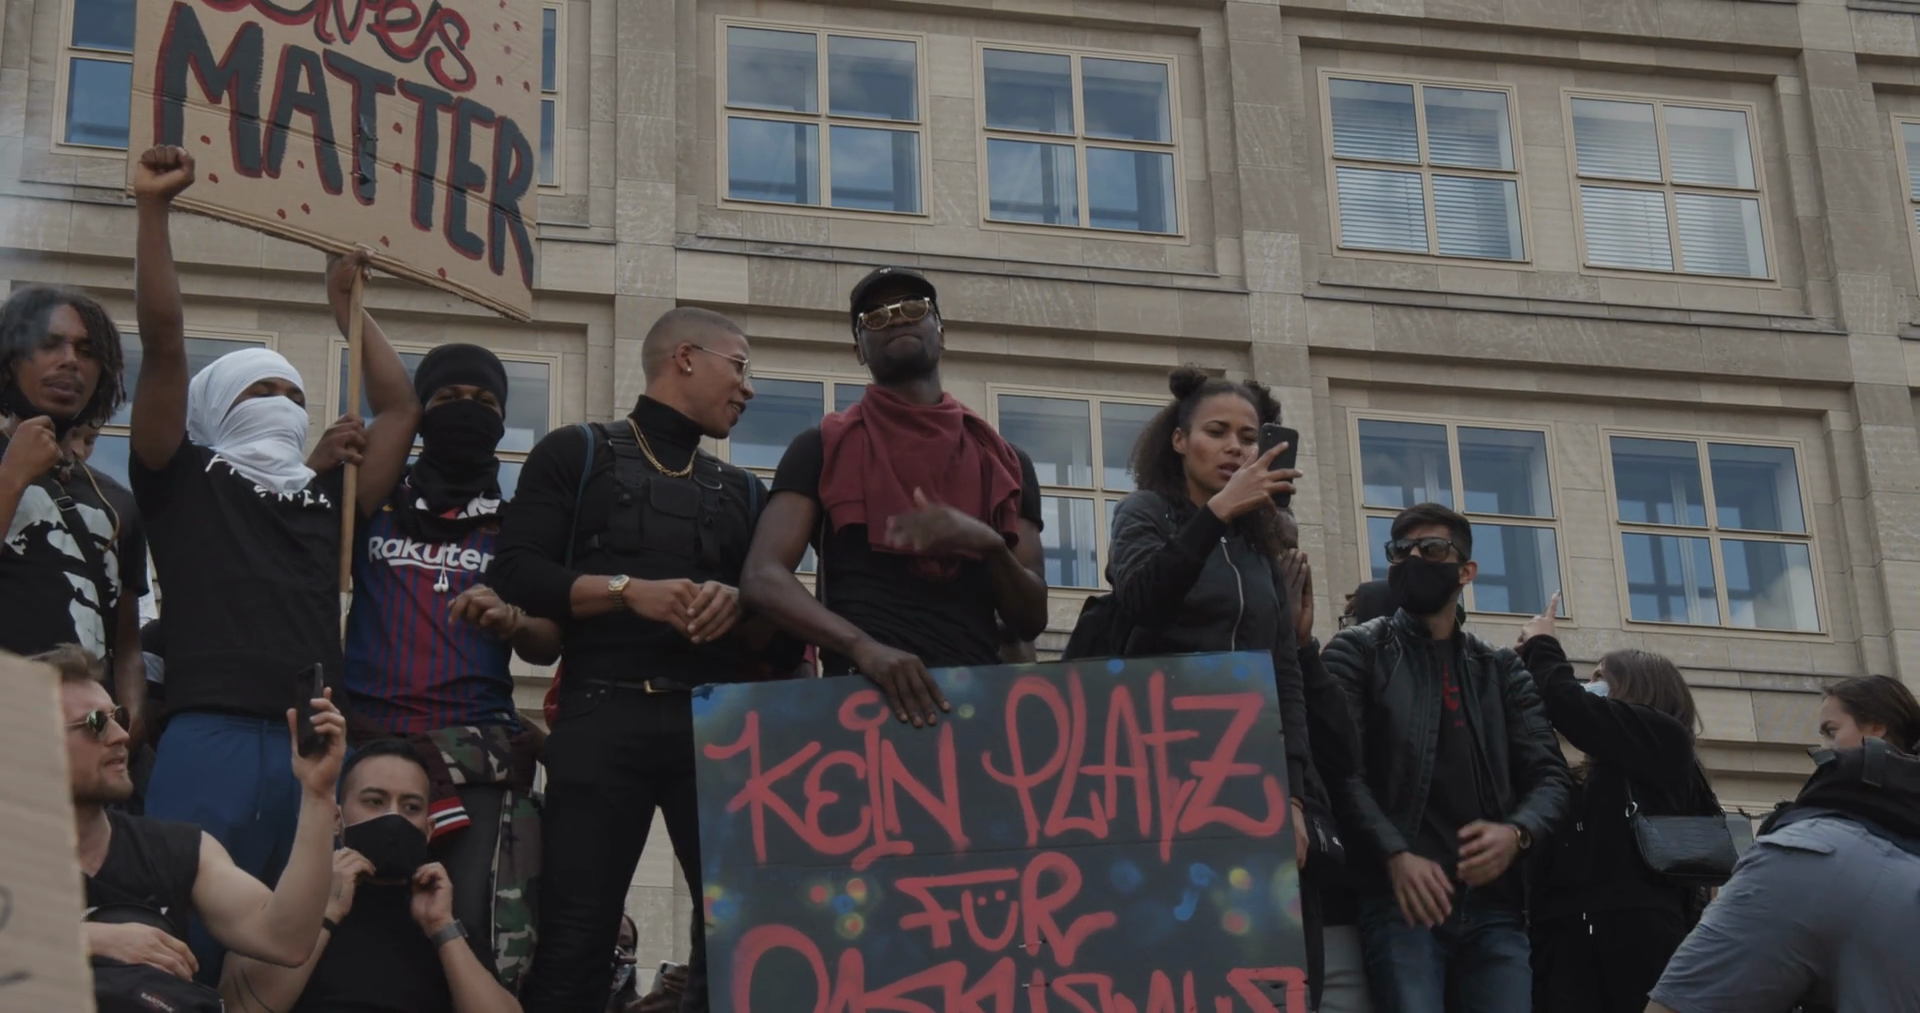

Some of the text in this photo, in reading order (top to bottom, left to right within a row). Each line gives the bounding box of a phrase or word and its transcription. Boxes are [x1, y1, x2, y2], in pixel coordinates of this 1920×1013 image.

[203, 0, 477, 92] ives
[153, 1, 534, 289] MATTER
[982, 671, 1286, 863] PLATZ
[895, 852, 1116, 967] FÜR
